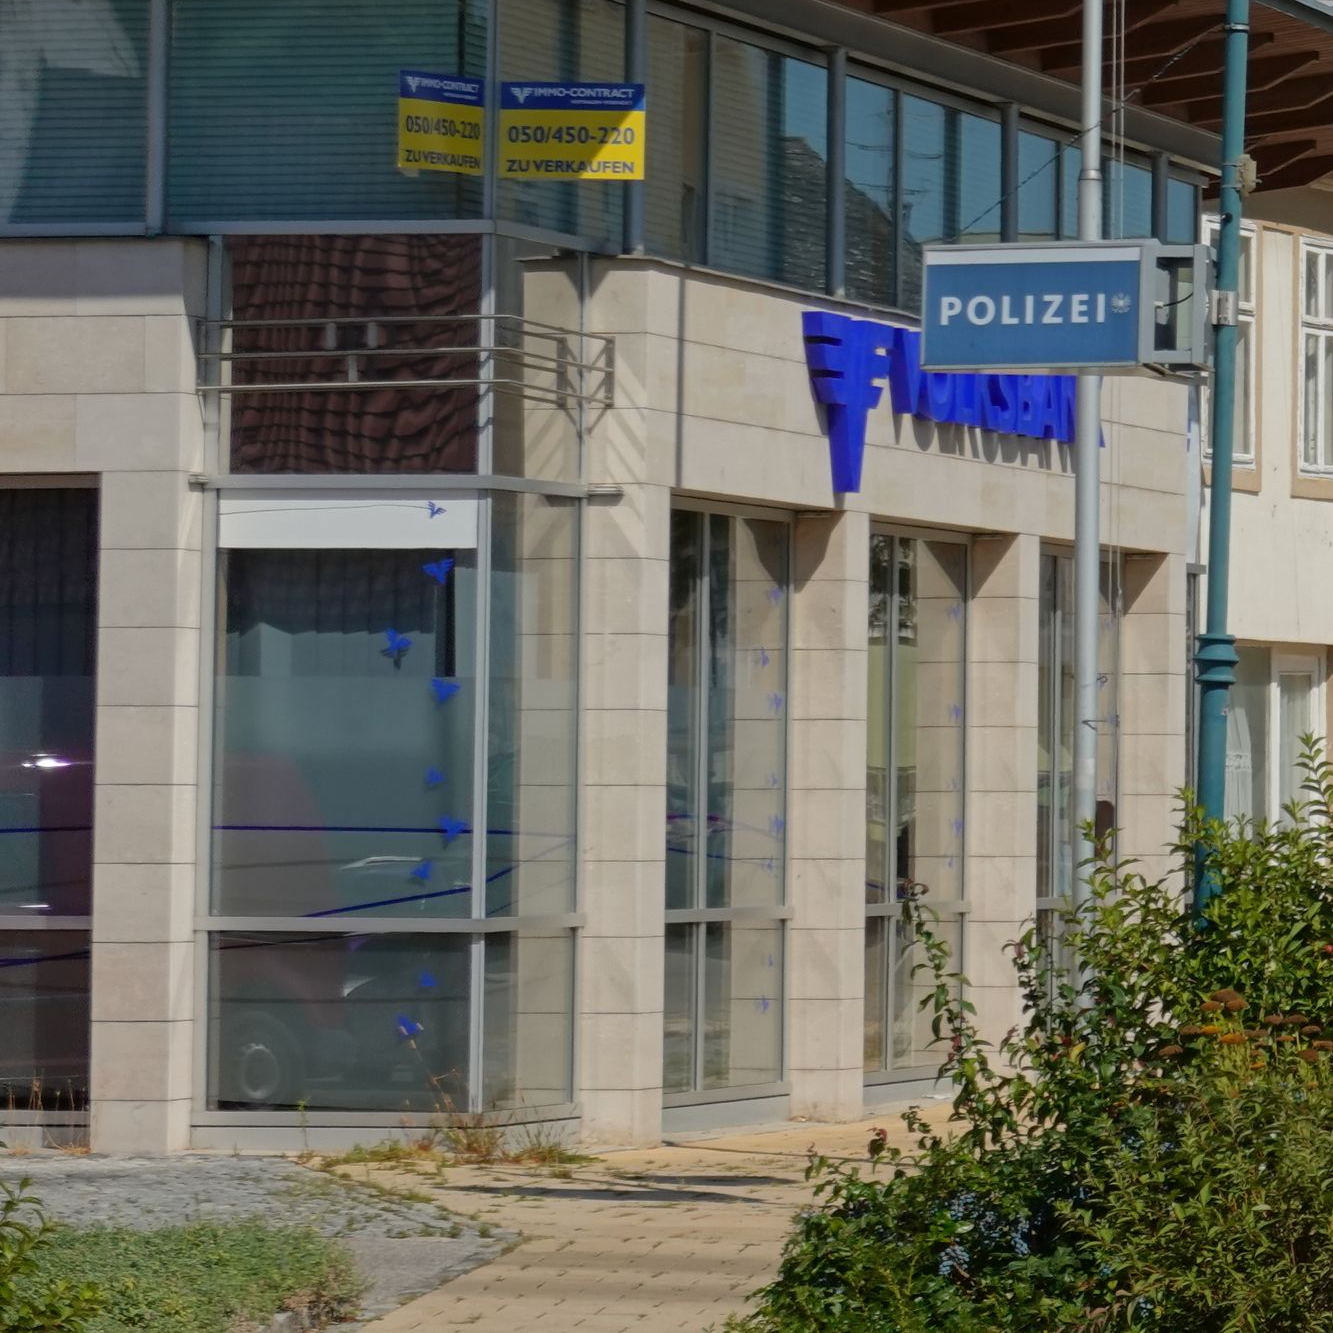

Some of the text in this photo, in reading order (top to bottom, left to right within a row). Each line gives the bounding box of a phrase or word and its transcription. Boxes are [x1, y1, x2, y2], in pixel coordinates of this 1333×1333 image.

[534, 87, 635, 98] IMMO-CONTRACT
[405, 115, 481, 141] 050/450-220
[508, 125, 635, 145] 050/450-220
[405, 149, 481, 169] ZU VERKAUFEN
[506, 159, 635, 174] ZU VERKAUFEN
[940, 294, 1106, 326] POLIZEI
[889, 326, 1106, 449] VOLKSBAN
